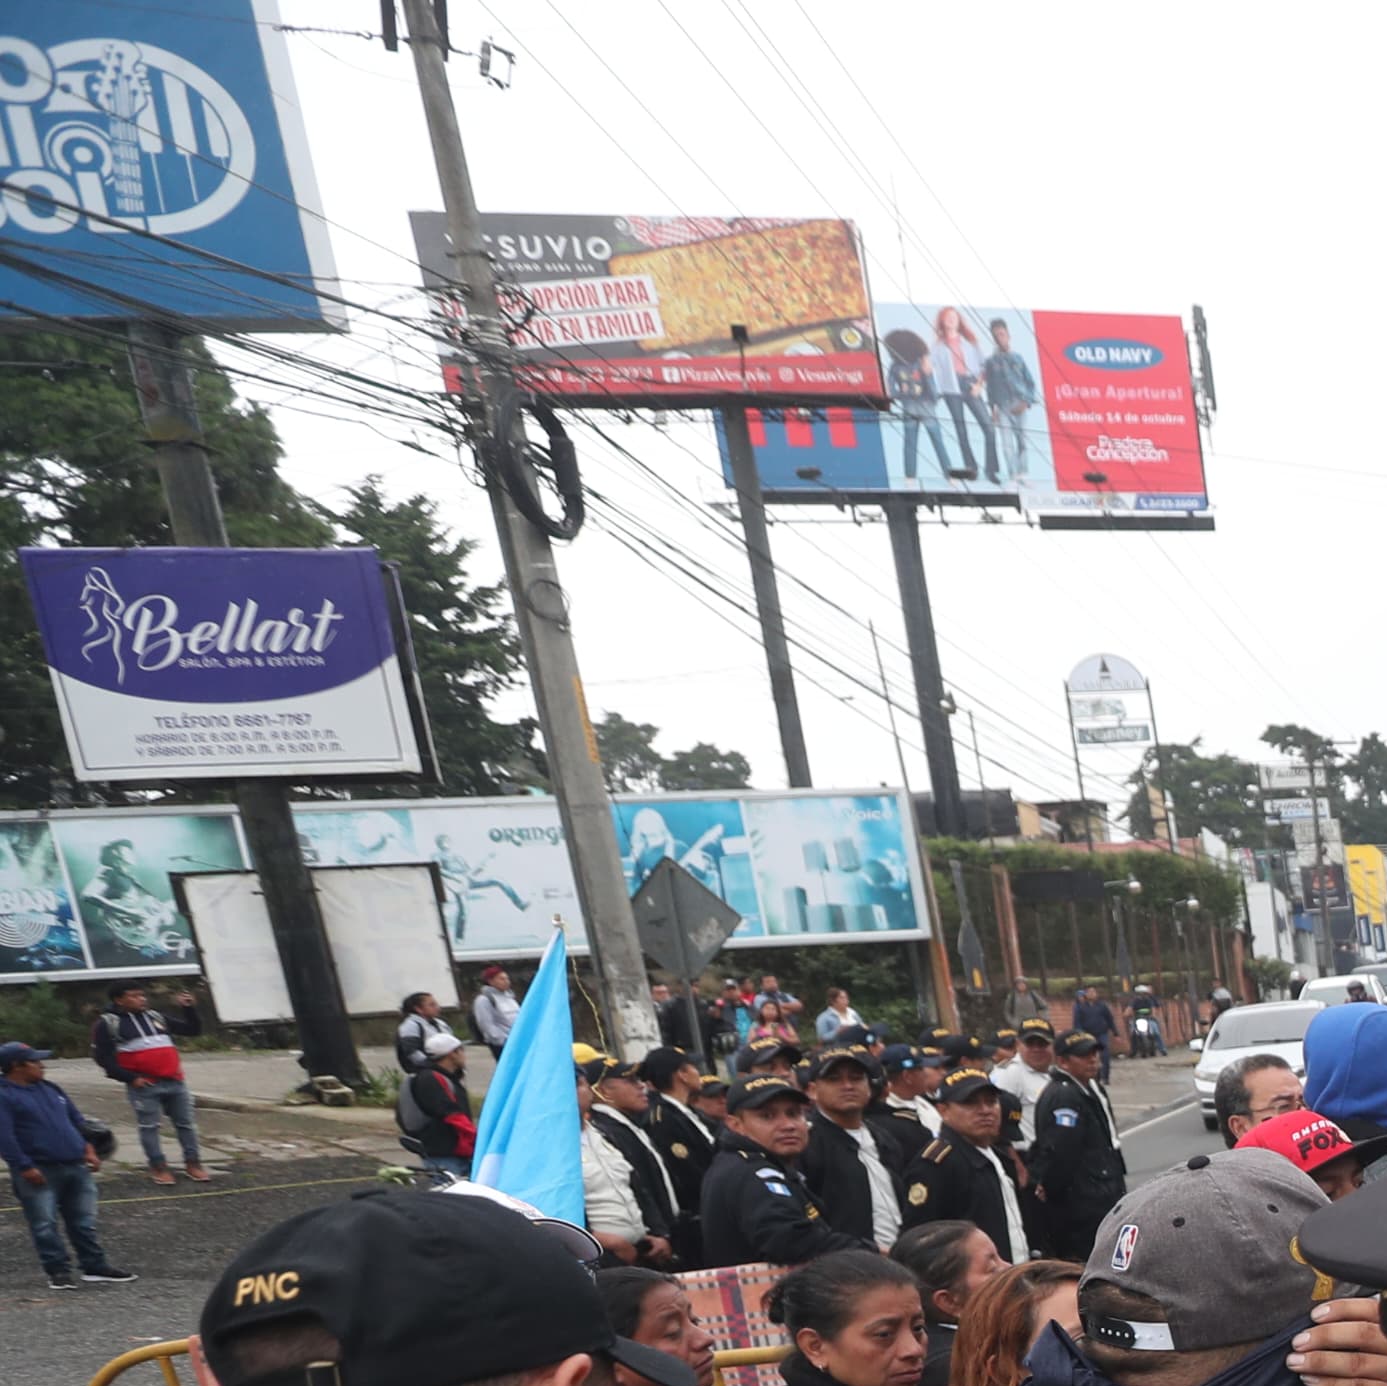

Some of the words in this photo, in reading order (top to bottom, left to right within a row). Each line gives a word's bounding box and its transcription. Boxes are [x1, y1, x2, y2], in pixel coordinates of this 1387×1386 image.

[602, 279, 650, 304] PARA
[558, 317, 583, 342] EN
[585, 311, 657, 339] FAMILIA
[1073, 346, 1108, 363] OLD
[1110, 347, 1153, 364] NAVY
[123, 594, 345, 671] Bellart
[234, 1270, 300, 1308] PNC
